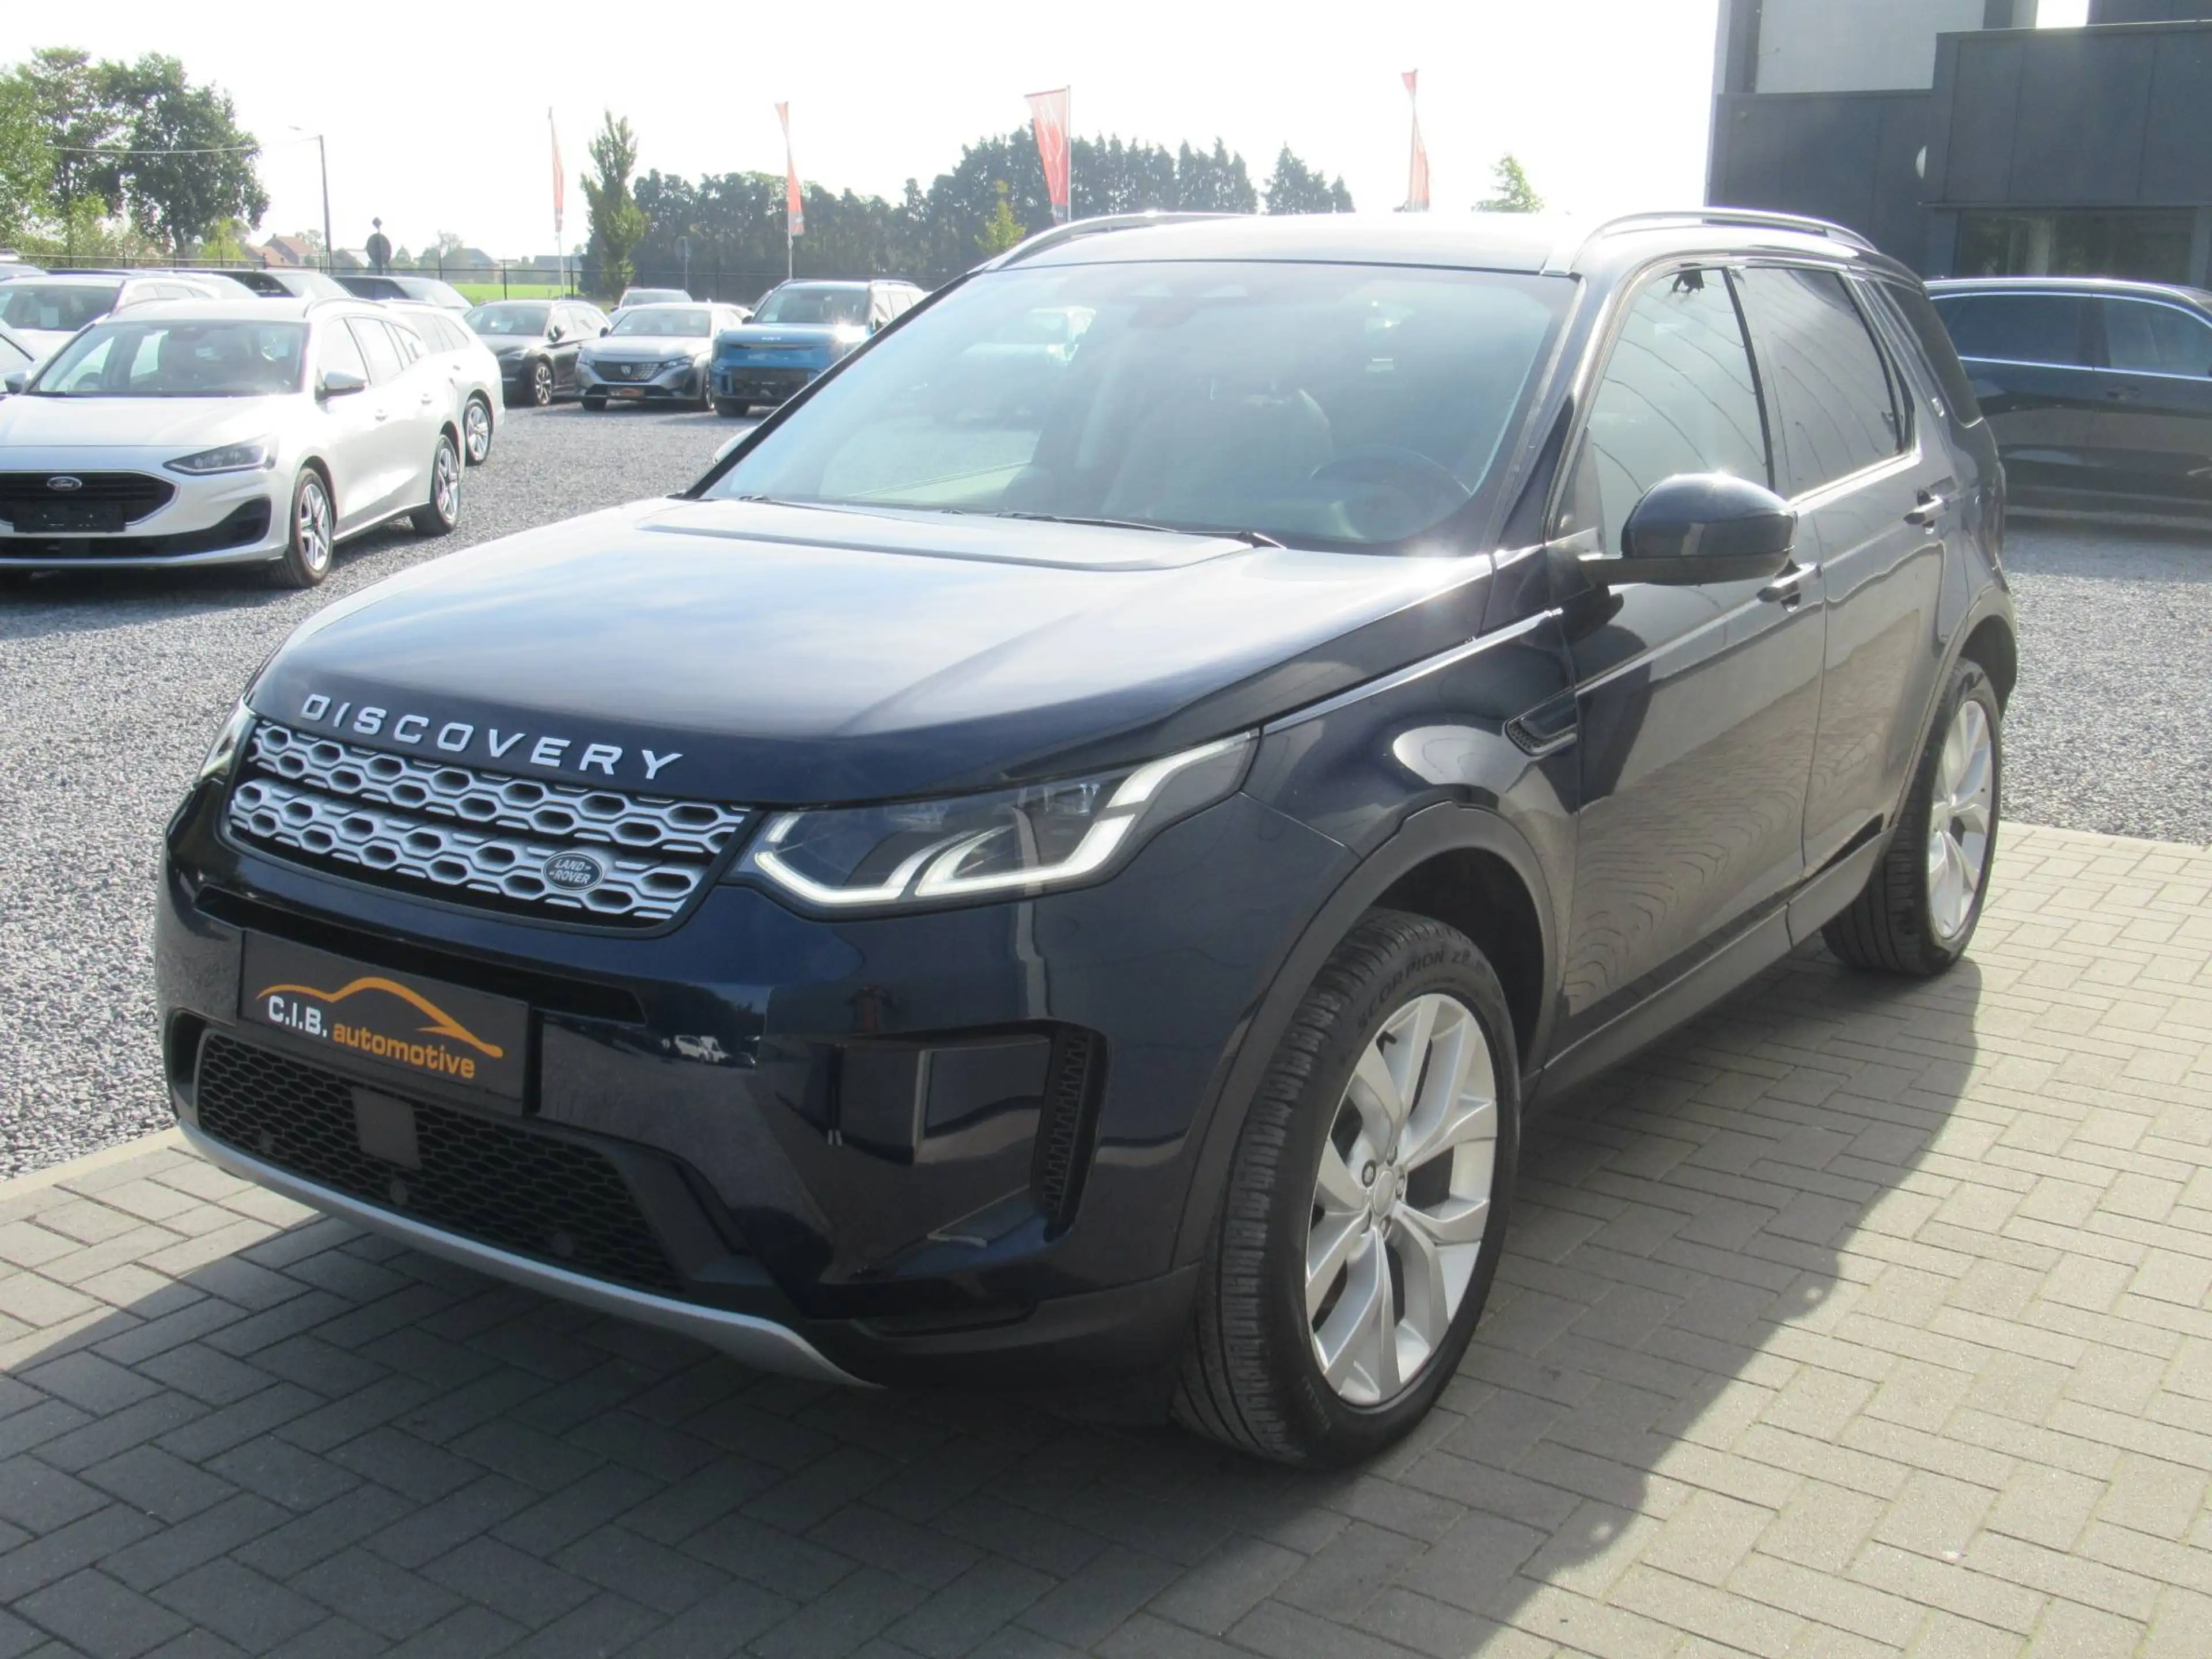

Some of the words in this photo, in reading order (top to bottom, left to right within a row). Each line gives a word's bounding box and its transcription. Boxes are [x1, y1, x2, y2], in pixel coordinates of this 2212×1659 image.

[300, 693, 684, 781] DISCOVERY
[554, 870, 591, 884] ROVER
[555, 859, 585, 871] LAND
[268, 995, 327, 1038] C.I.B.
[332, 1022, 476, 1080] automotive
